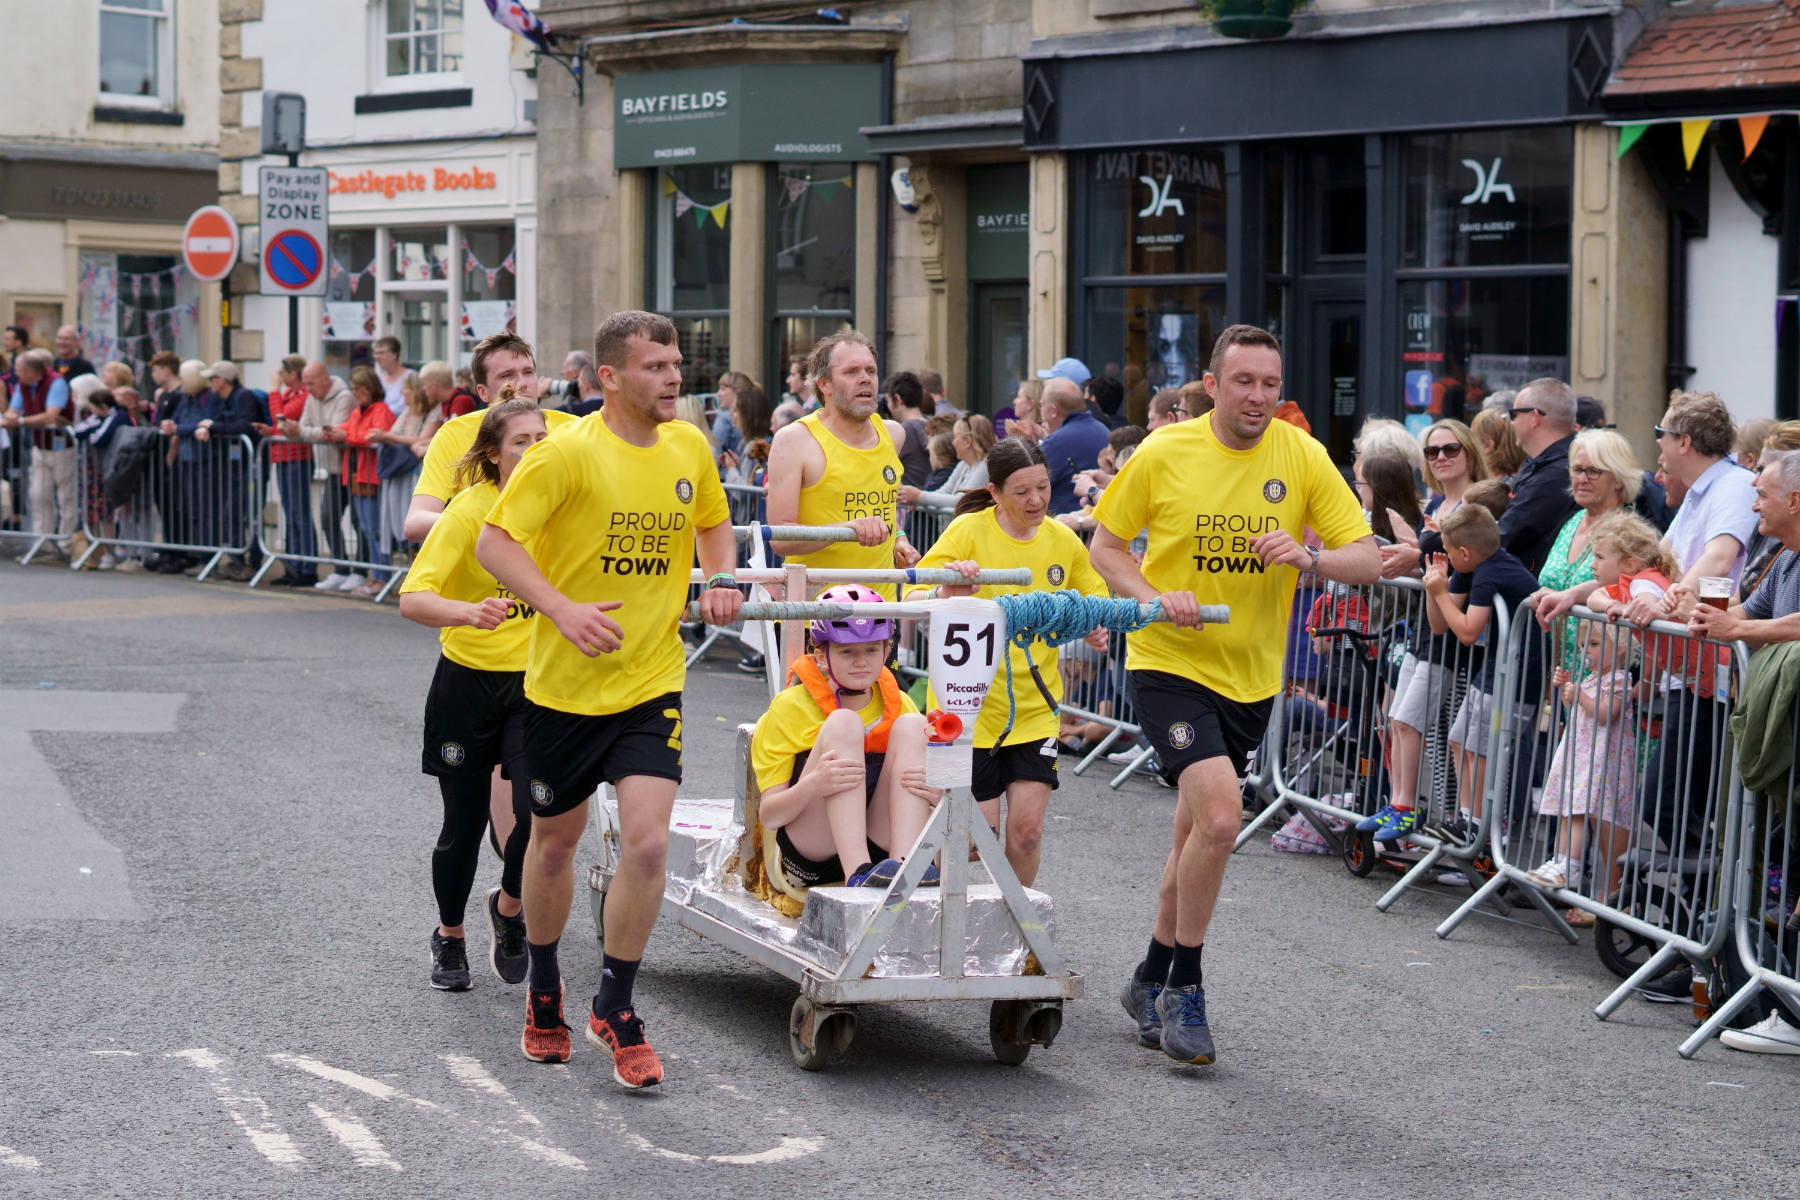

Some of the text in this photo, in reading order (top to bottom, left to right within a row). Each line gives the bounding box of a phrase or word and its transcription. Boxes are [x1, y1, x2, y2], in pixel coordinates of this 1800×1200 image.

[622, 90, 728, 116] BAYFIELDS
[774, 143, 842, 153] AUDIOLOGISTS
[266, 171, 321, 187] Pay and
[433, 165, 497, 191] Books
[267, 187, 320, 202] Display
[266, 204, 322, 220] ZONE
[977, 213, 1029, 228] BAYFIE
[1408, 312, 1431, 329] CREW
[845, 490, 897, 506] PROUD
[609, 512, 686, 531] PROUD
[1196, 514, 1280, 533] PROUD
[606, 534, 670, 553] TO BE
[1194, 536, 1224, 552] TO
[600, 556, 670, 575] TOWN
[1193, 556, 1265, 574] TOWN
[942, 622, 995, 667] 51
[946, 682, 989, 694] Piccadilly
